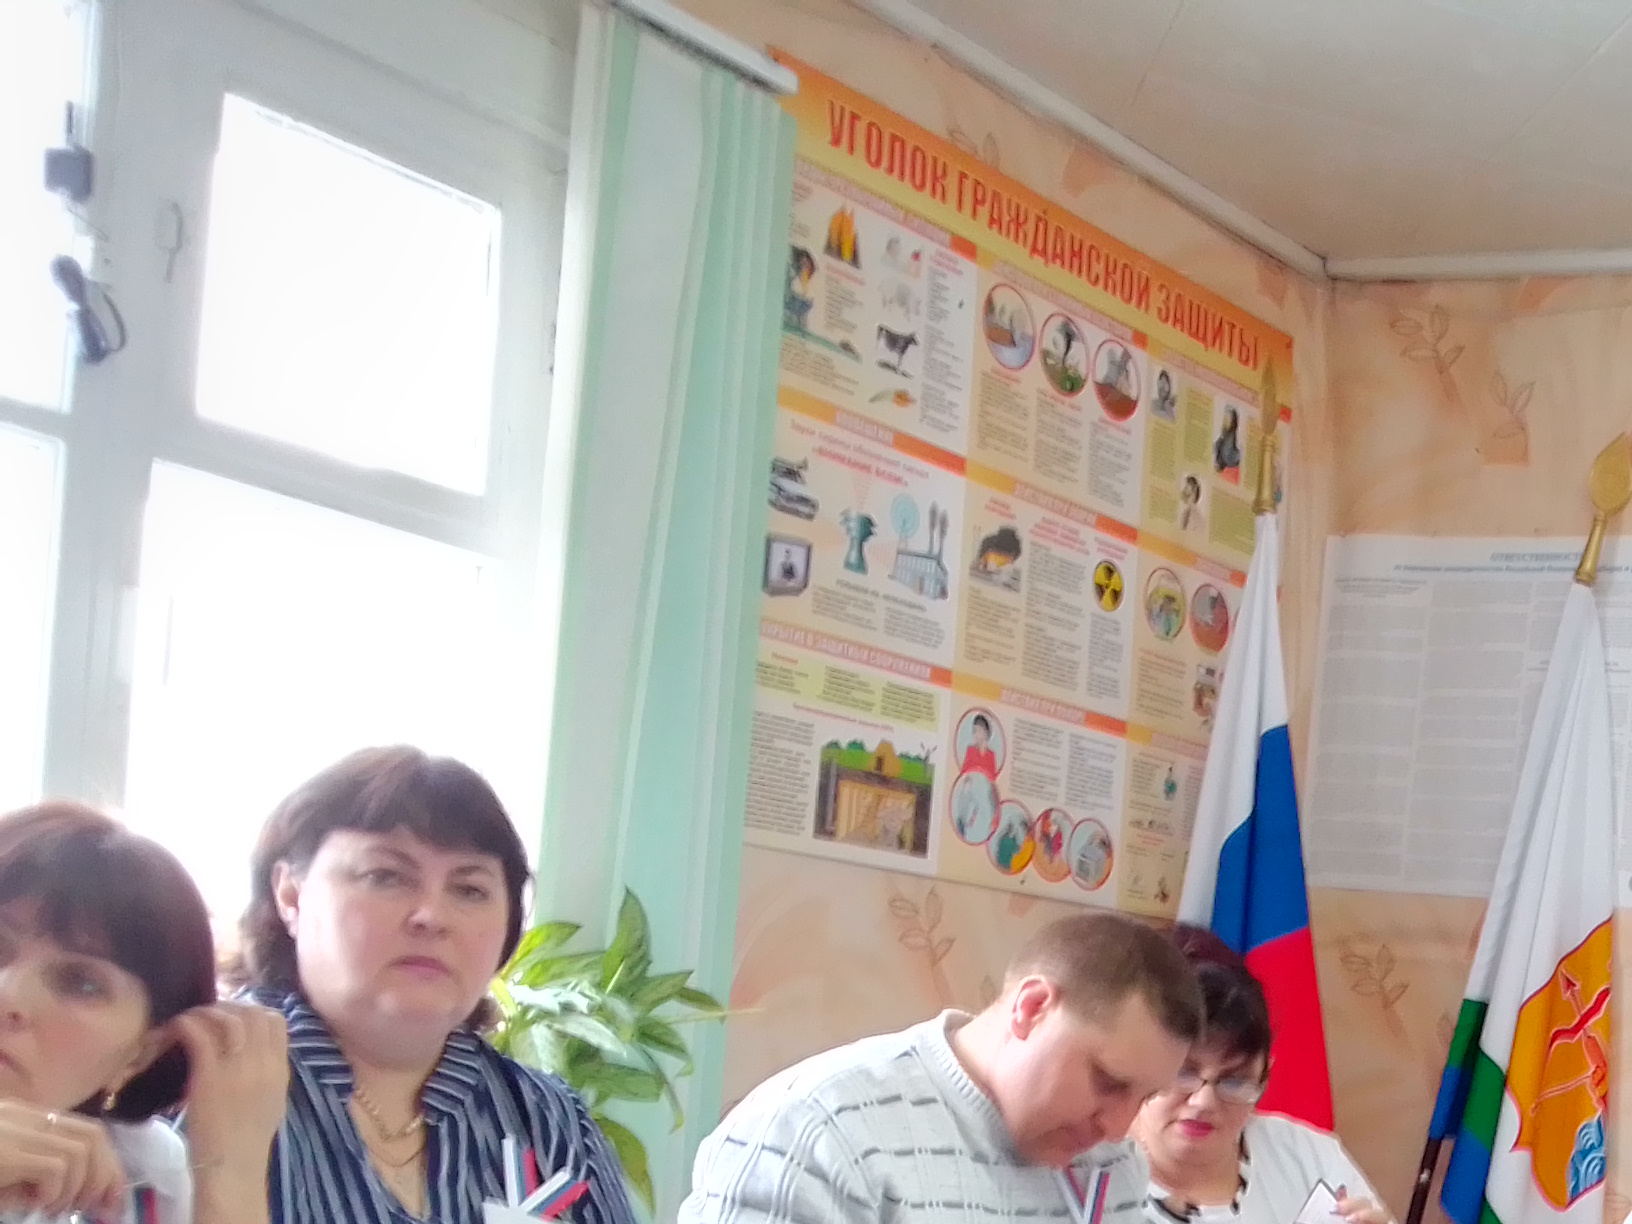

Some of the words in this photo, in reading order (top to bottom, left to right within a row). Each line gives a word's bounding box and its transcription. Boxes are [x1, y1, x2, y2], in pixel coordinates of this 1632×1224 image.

[827, 99, 947, 204] УГОЛОК
[956, 171, 1150, 315] ГРАЖДАНСКОЙ
[1157, 283, 1259, 371] ЗАЩИТЫ
